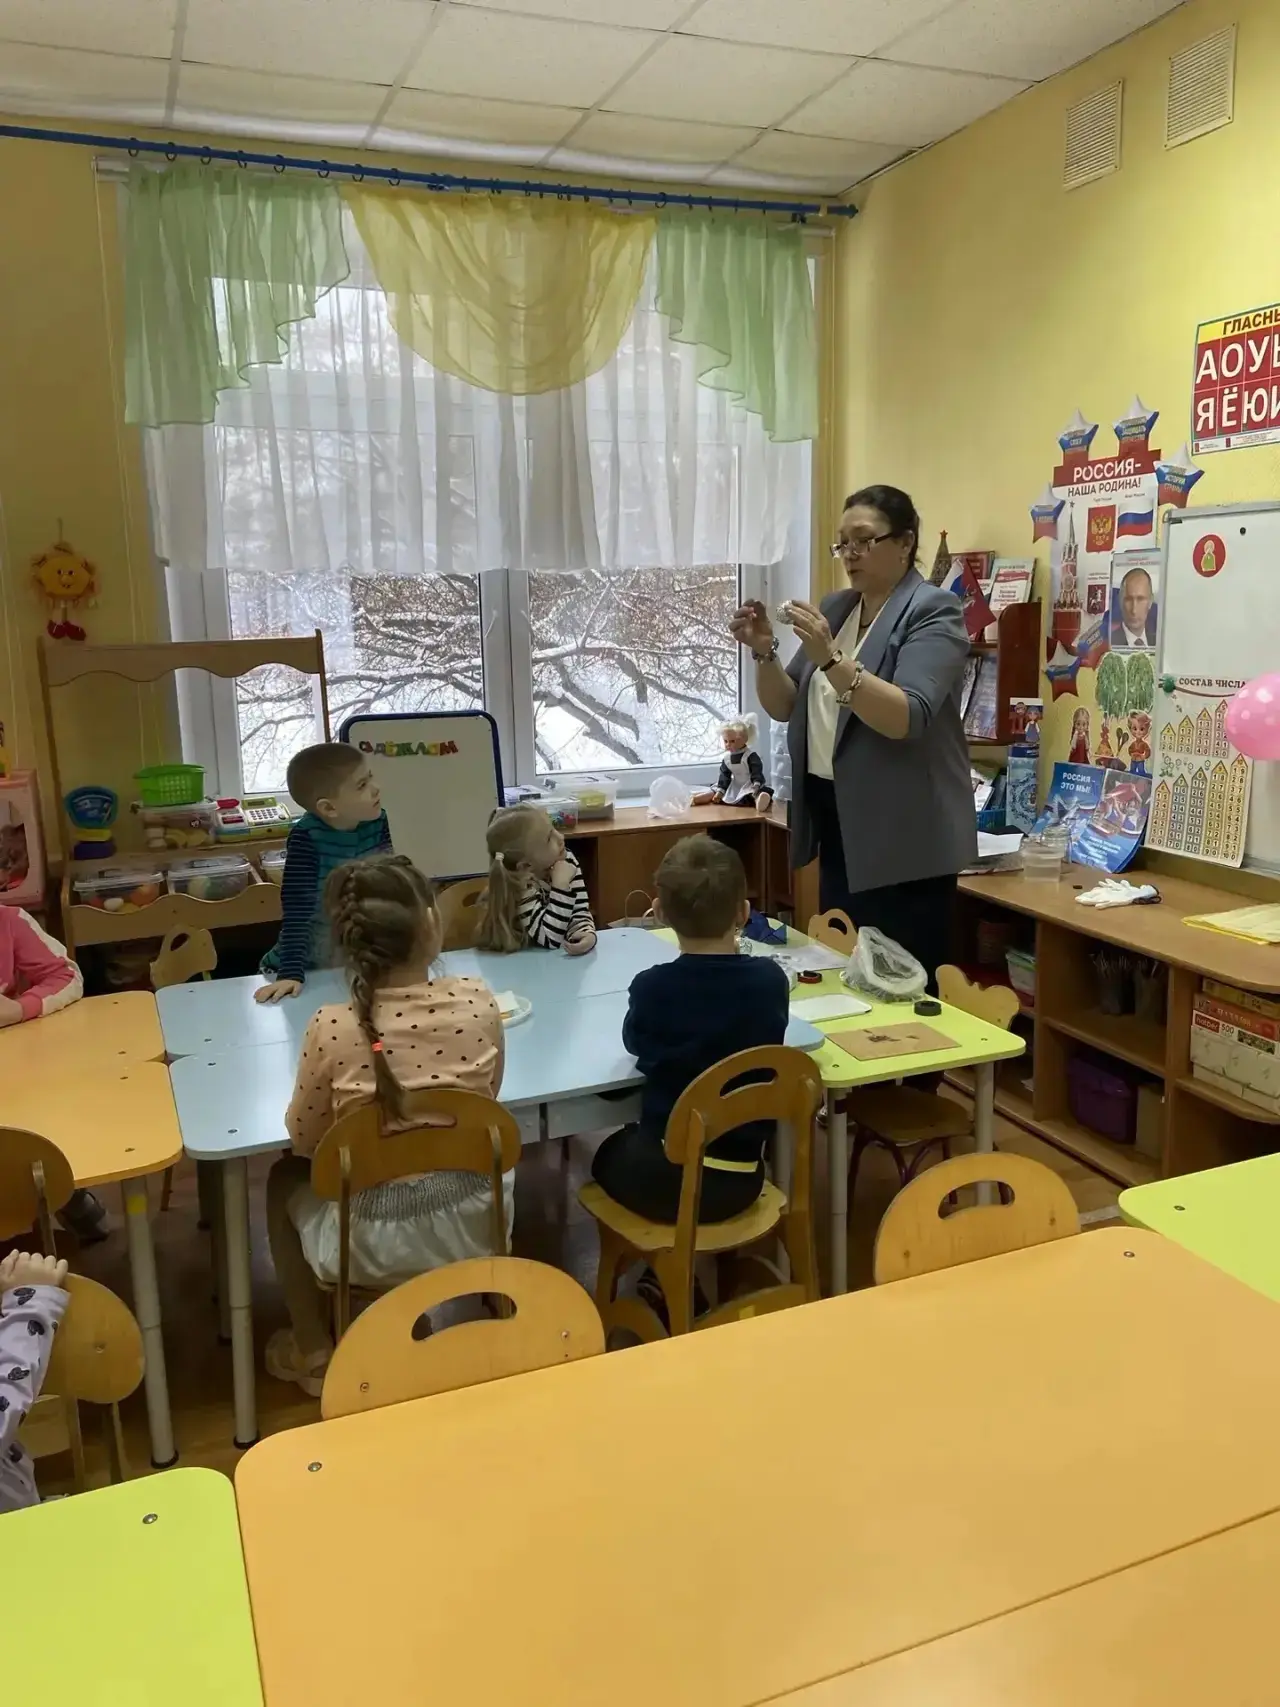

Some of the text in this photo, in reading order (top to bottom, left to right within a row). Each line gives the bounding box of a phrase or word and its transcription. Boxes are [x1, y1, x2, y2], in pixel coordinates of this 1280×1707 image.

[1196, 333, 1280, 384] АОУ
[1073, 458, 1141, 482] РОССИЯ-
[1068, 478, 1141, 497] НАША РОДИНА!
[1179, 678, 1212, 686] СОСТАВ
[1063, 772, 1091, 783] РОССИЯ
[1061, 782, 1074, 790] ЭТО
[1221, 1024, 1235, 1034] 500
